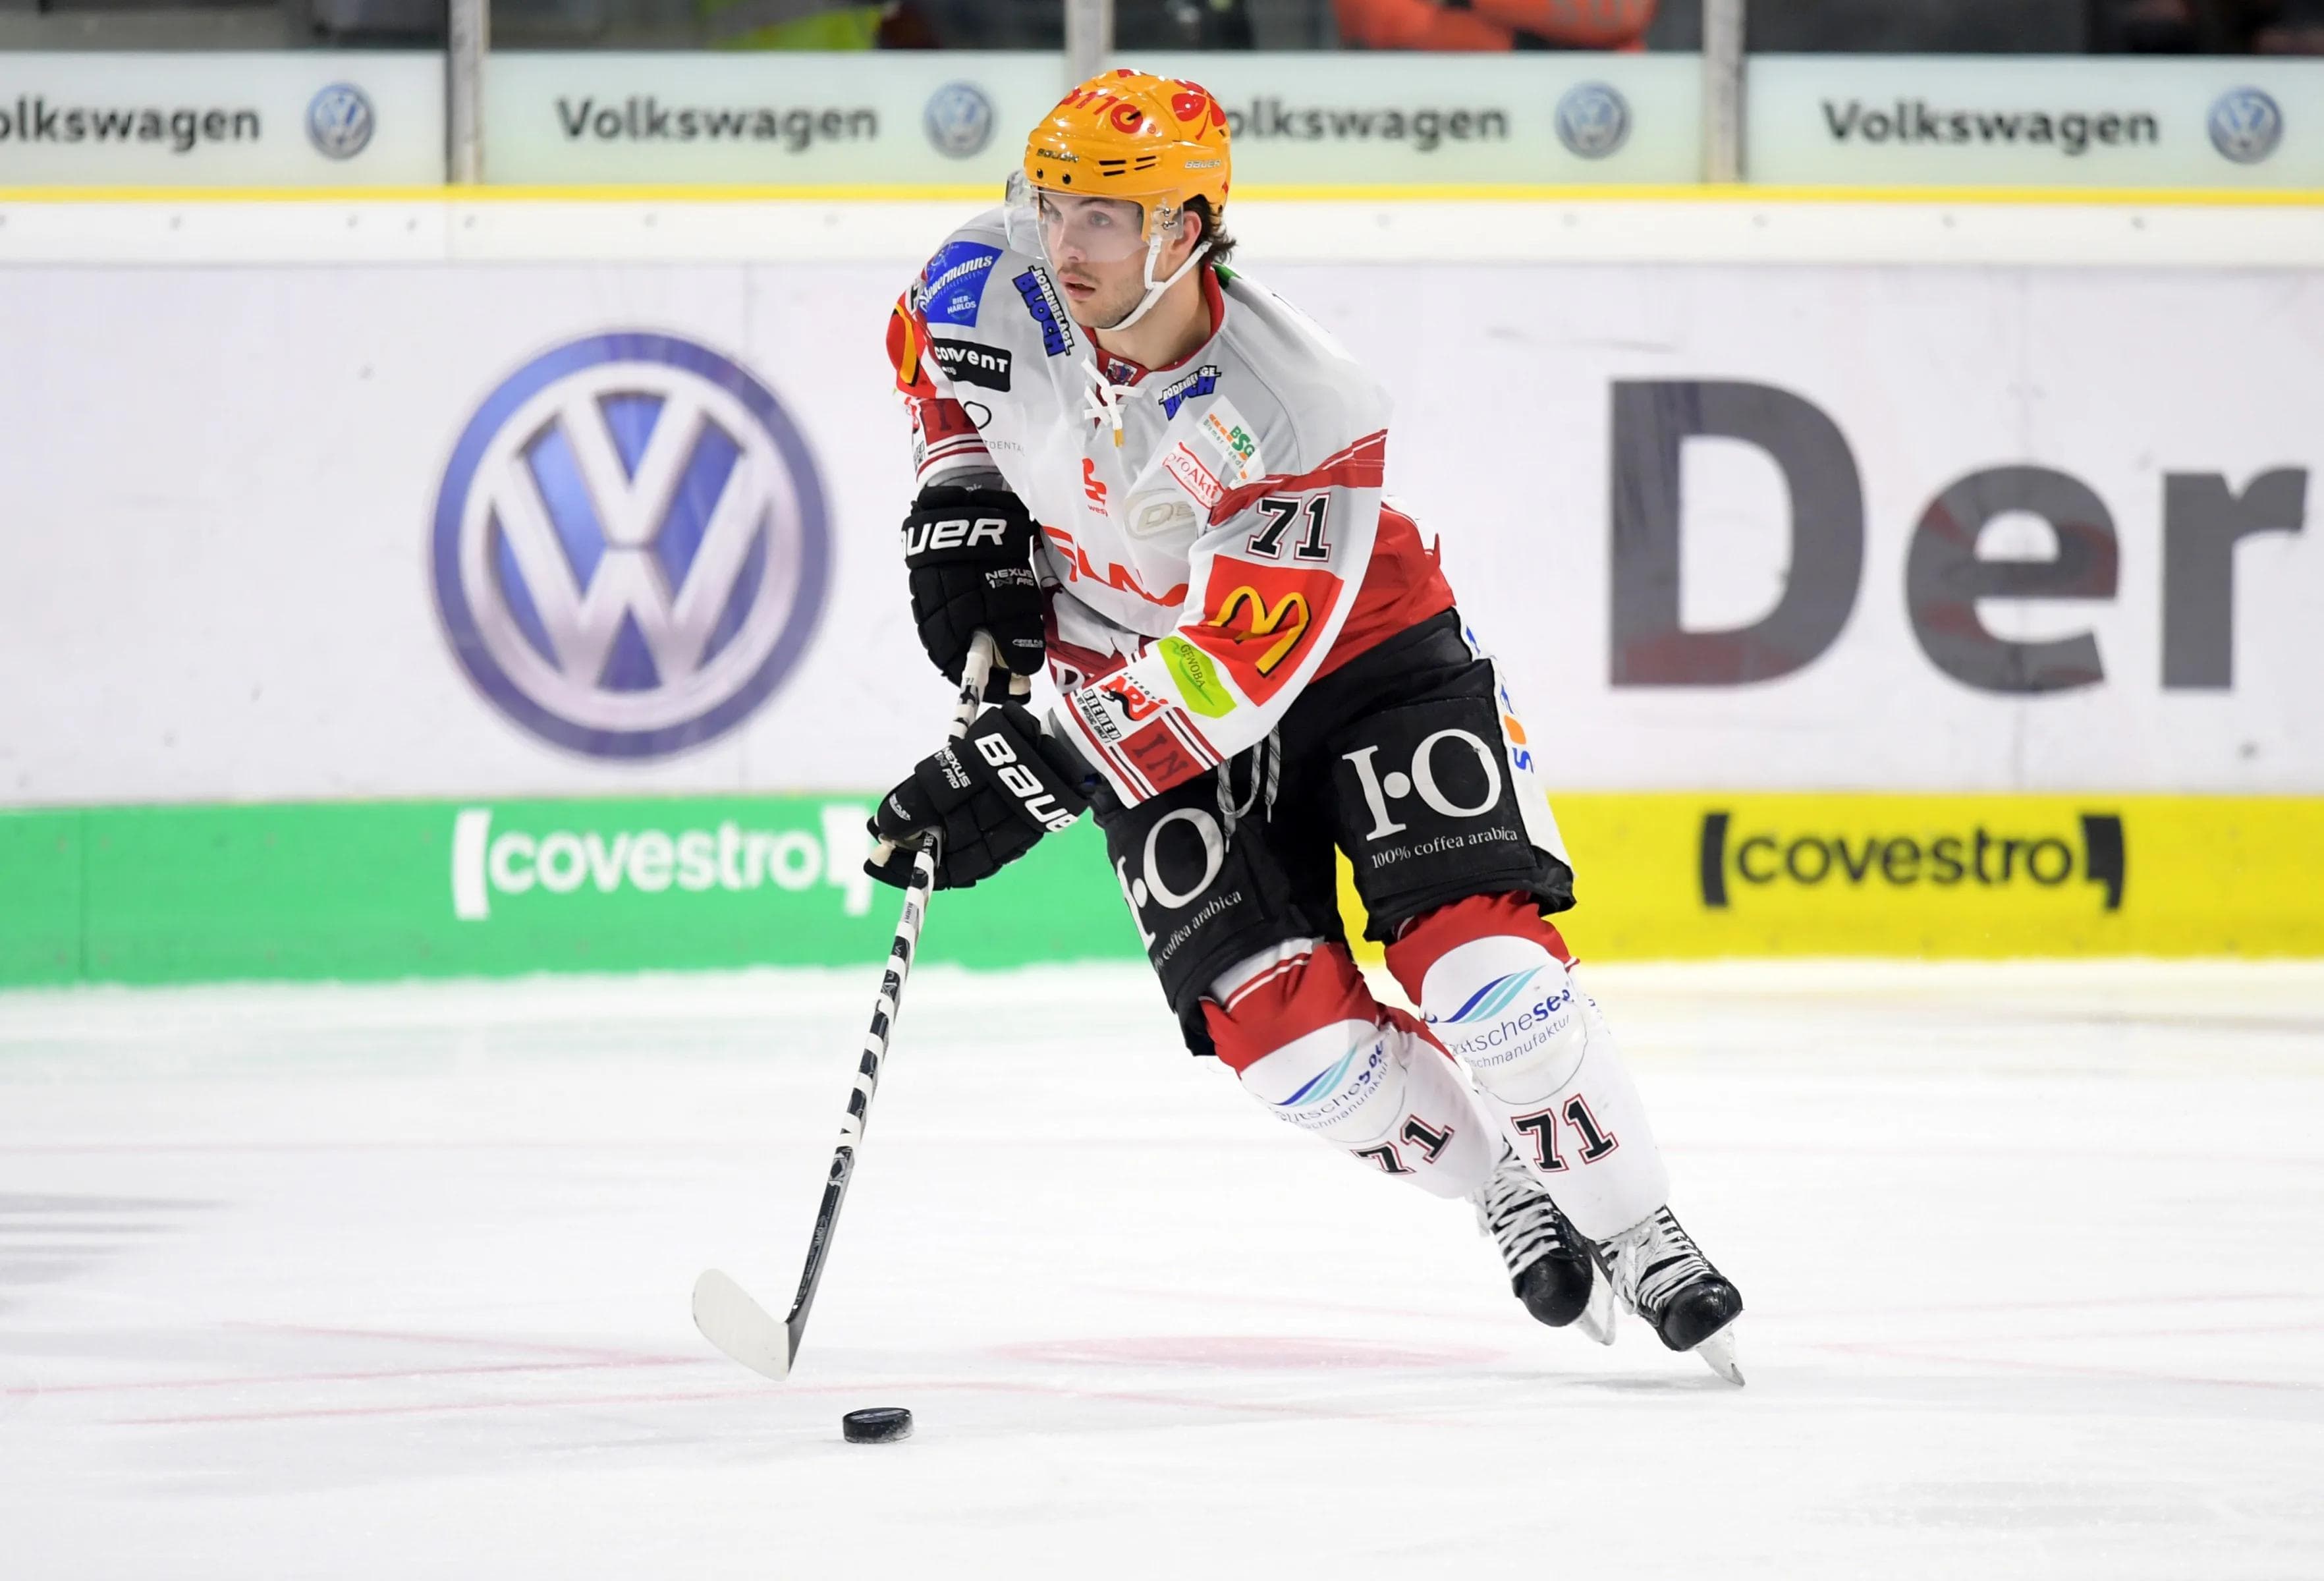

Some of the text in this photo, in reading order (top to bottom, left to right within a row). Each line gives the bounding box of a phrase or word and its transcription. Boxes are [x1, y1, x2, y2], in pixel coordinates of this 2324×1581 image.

[556, 96, 879, 153] Volkswagen
[1229, 97, 1509, 153] olkswagen
[1821, 99, 2159, 156] Volkswagen
[947, 301, 976, 315] HARLOS
[1012, 269, 1066, 358] BLOCH
[1230, 425, 1256, 458] BSG
[902, 518, 1007, 560] UER
[1246, 491, 1332, 563] 71
[1607, 375, 2310, 700] Der
[985, 567, 1034, 581] NEXUS
[1081, 705, 1097, 725] MUSIC
[1093, 725, 1108, 739] ONLY
[1083, 689, 1122, 740] BREMEN
[942, 768, 960, 789] PRO
[489, 820, 823, 893] covestro
[1371, 826, 1518, 869] 100% coffea arabica
[1736, 826, 2074, 887] covestro
[1162, 891, 1242, 960] coffea arabica
[1349, 1114, 1454, 1175] 71
[1511, 1093, 1619, 1173] 71
